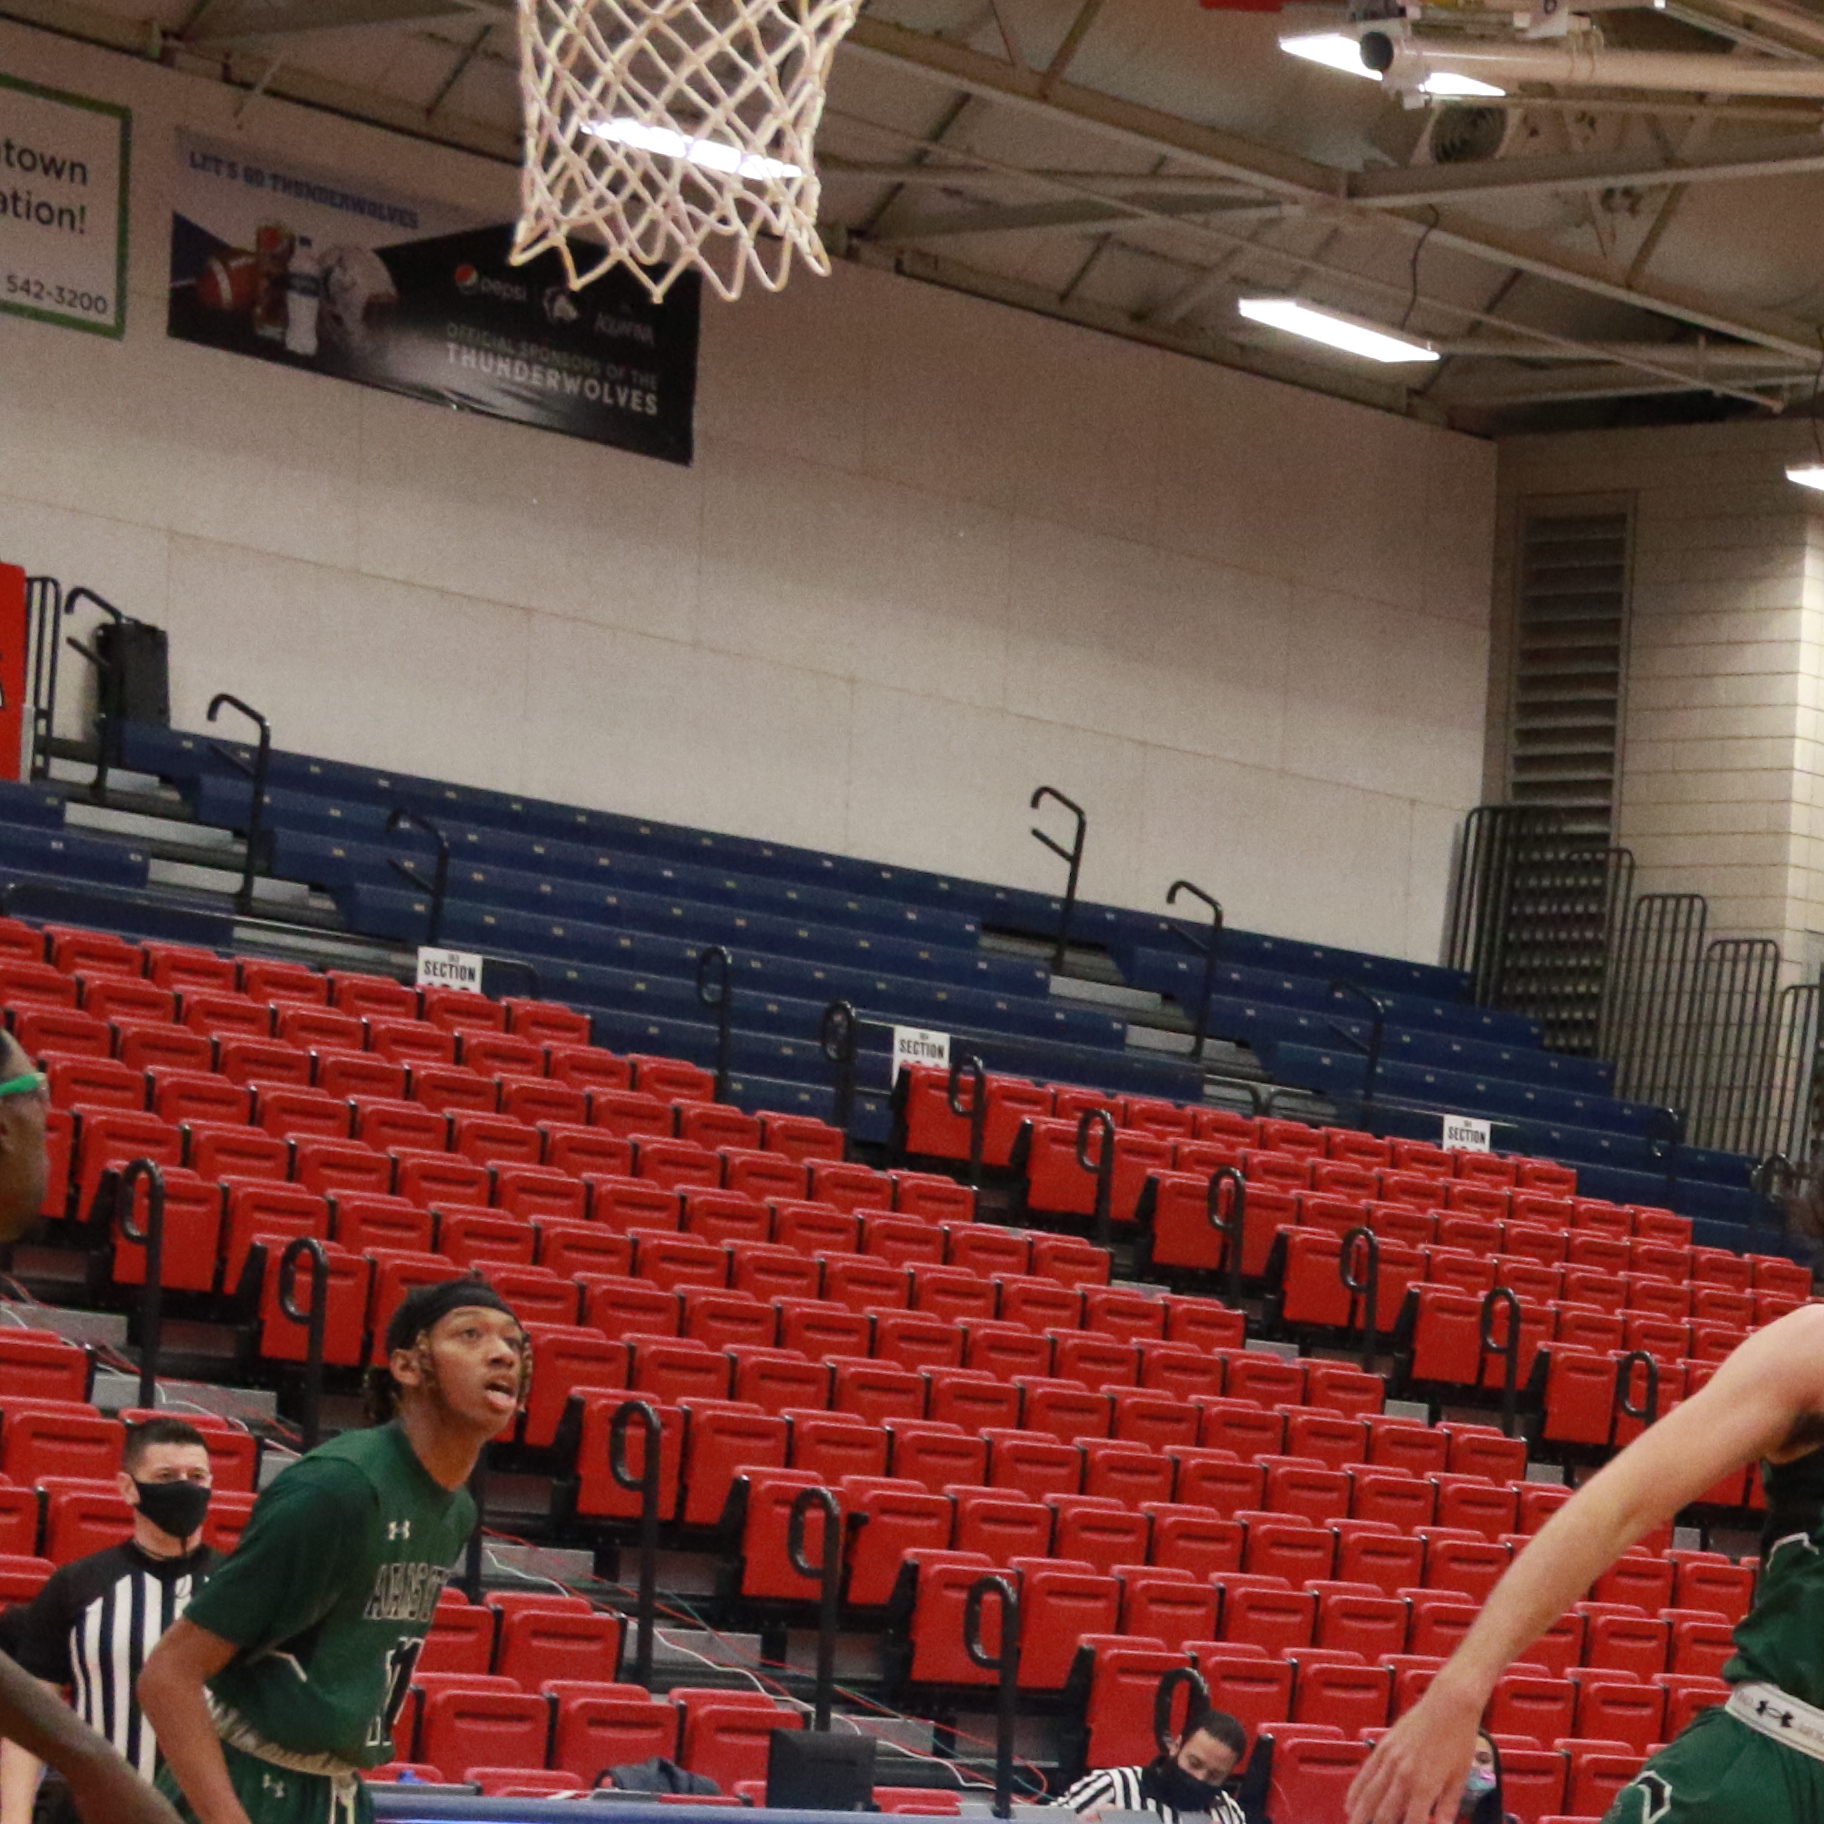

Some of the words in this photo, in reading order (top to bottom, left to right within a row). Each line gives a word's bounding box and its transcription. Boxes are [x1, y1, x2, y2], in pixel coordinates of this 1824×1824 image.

[6, 274, 108, 315] 542-3200
[447, 322, 516, 356] OFFICIAL
[631, 369, 659, 391] THE
[446, 341, 659, 417] THUNDERWOLVES
[423, 960, 477, 983] SECTION
[899, 1039, 946, 1060] SECTION
[1447, 1126, 1487, 1146] SECTION
